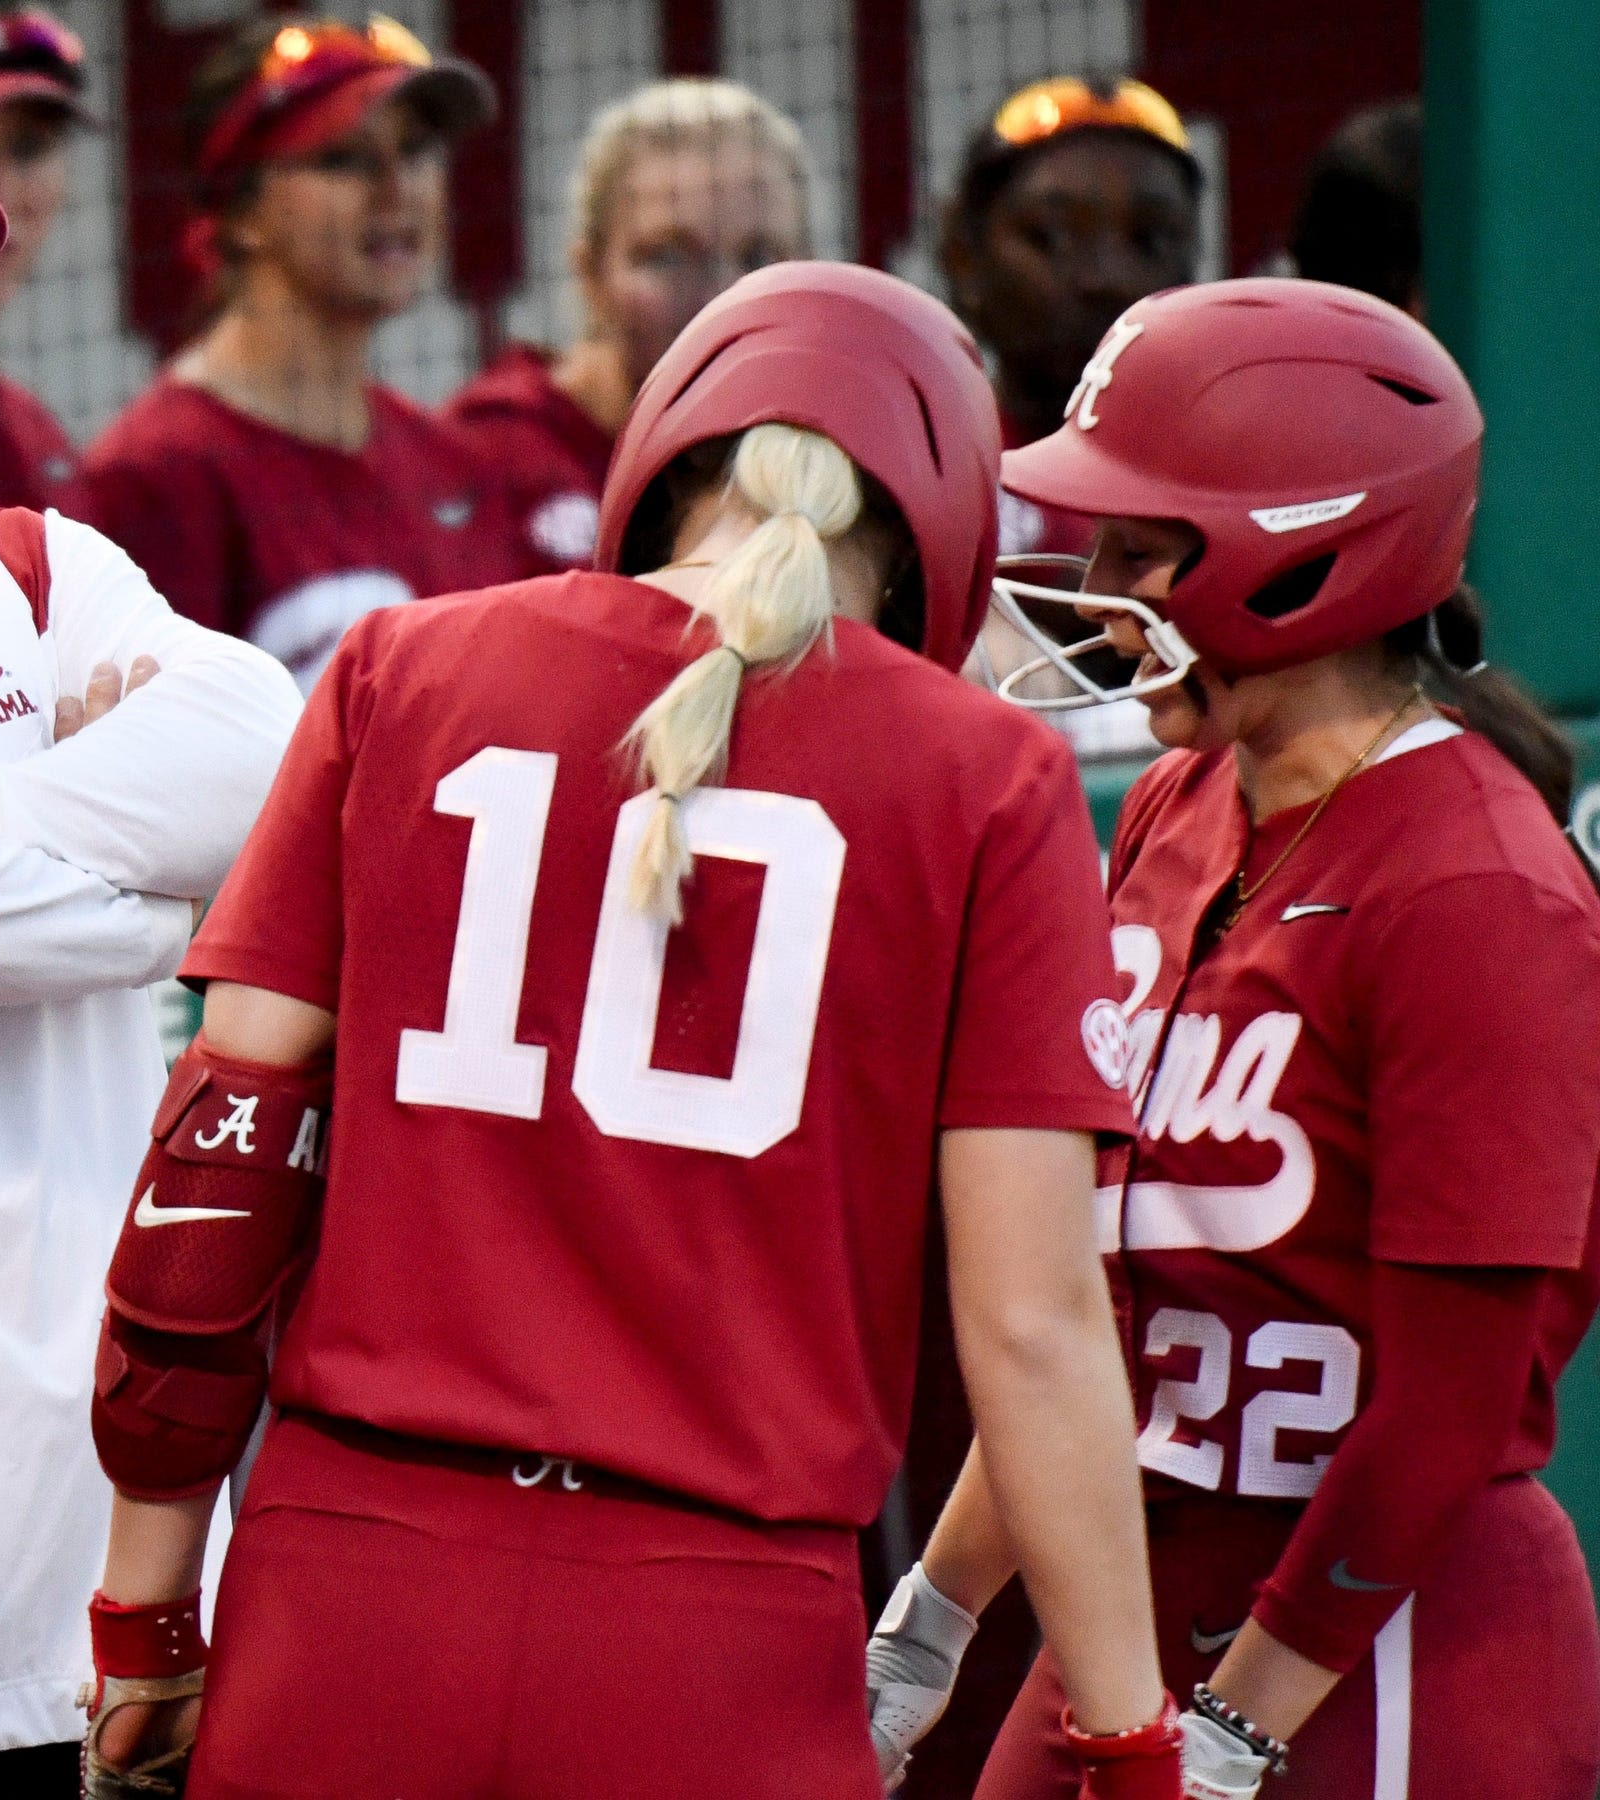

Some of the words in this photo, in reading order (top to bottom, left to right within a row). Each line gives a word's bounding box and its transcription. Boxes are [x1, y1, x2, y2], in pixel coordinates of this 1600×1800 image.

[1267, 503, 1342, 522] EASTON
[395, 745, 848, 1160] 10
[195, 1092, 259, 1154] A
[1135, 1306, 1361, 1499] 22
